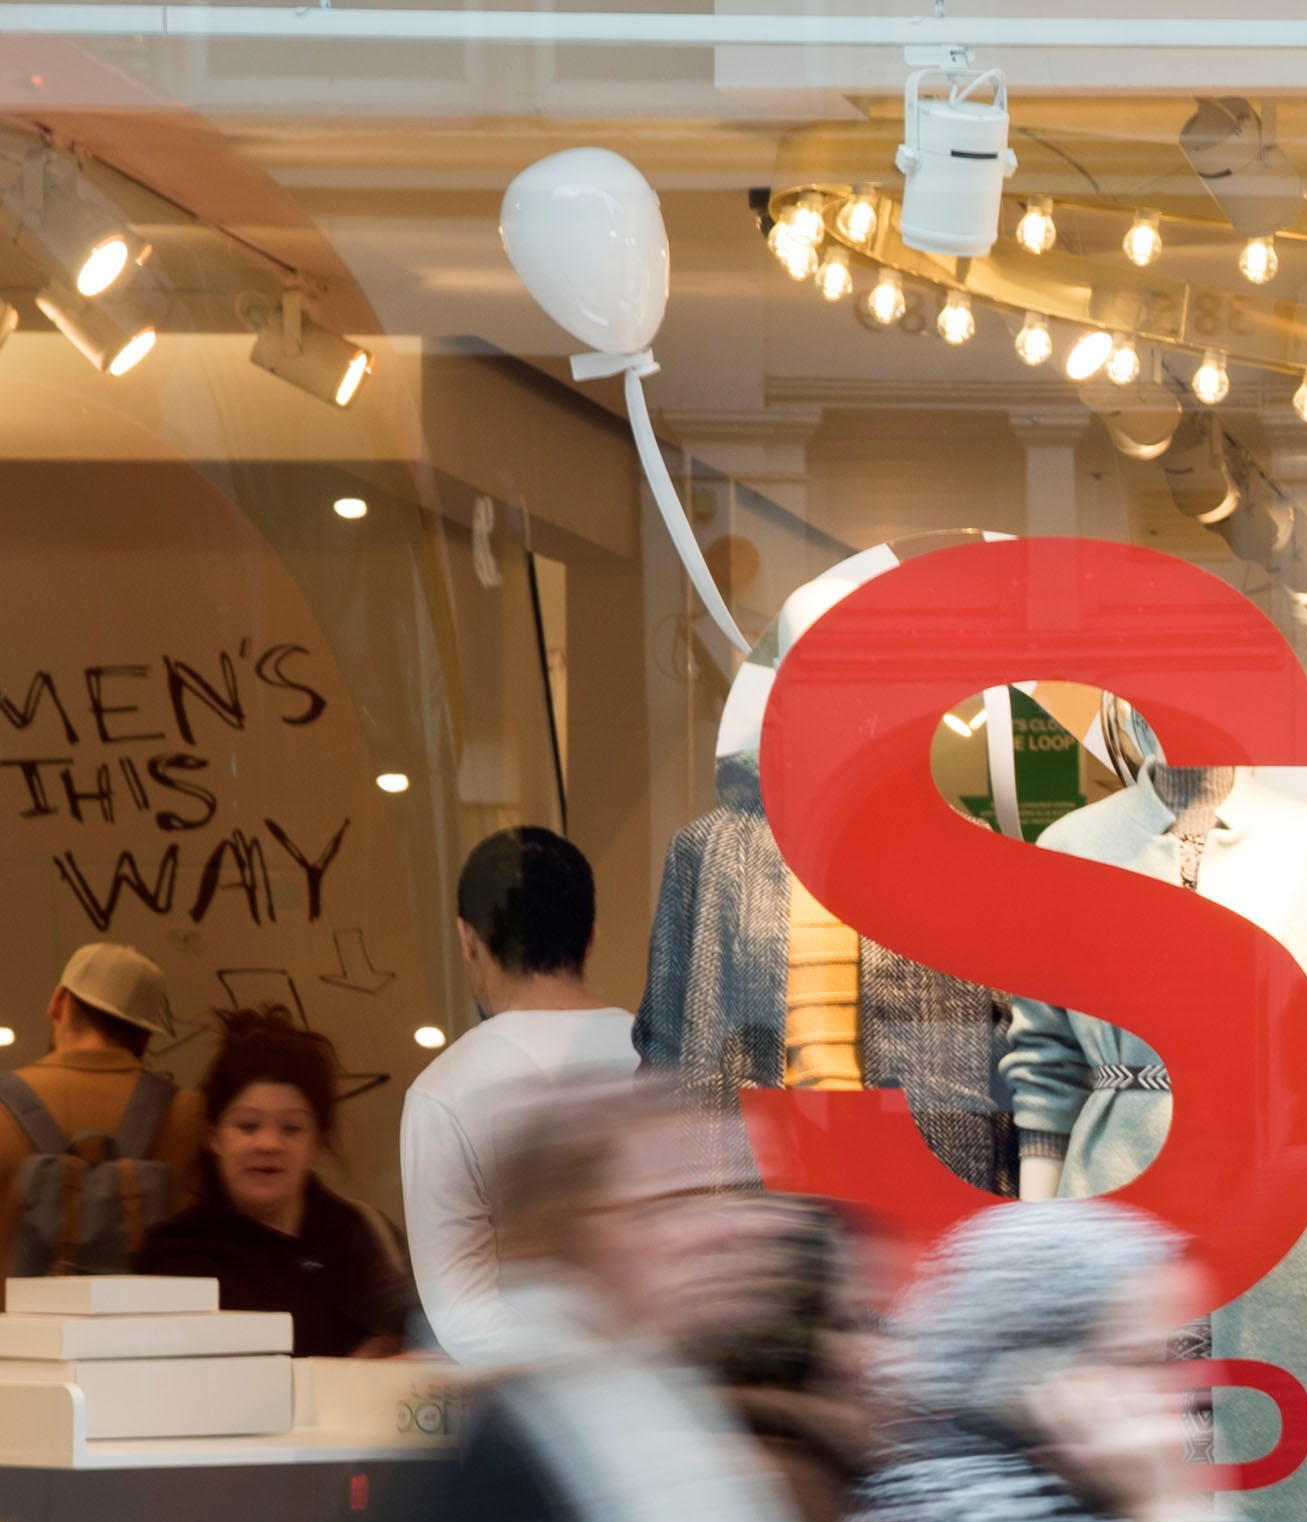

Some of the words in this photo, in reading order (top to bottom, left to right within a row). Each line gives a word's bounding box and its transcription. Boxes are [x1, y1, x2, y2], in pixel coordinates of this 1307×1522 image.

[0, 637, 327, 746] MEN'S
[0, 753, 218, 831] THIS
[53, 817, 351, 932] WAY
